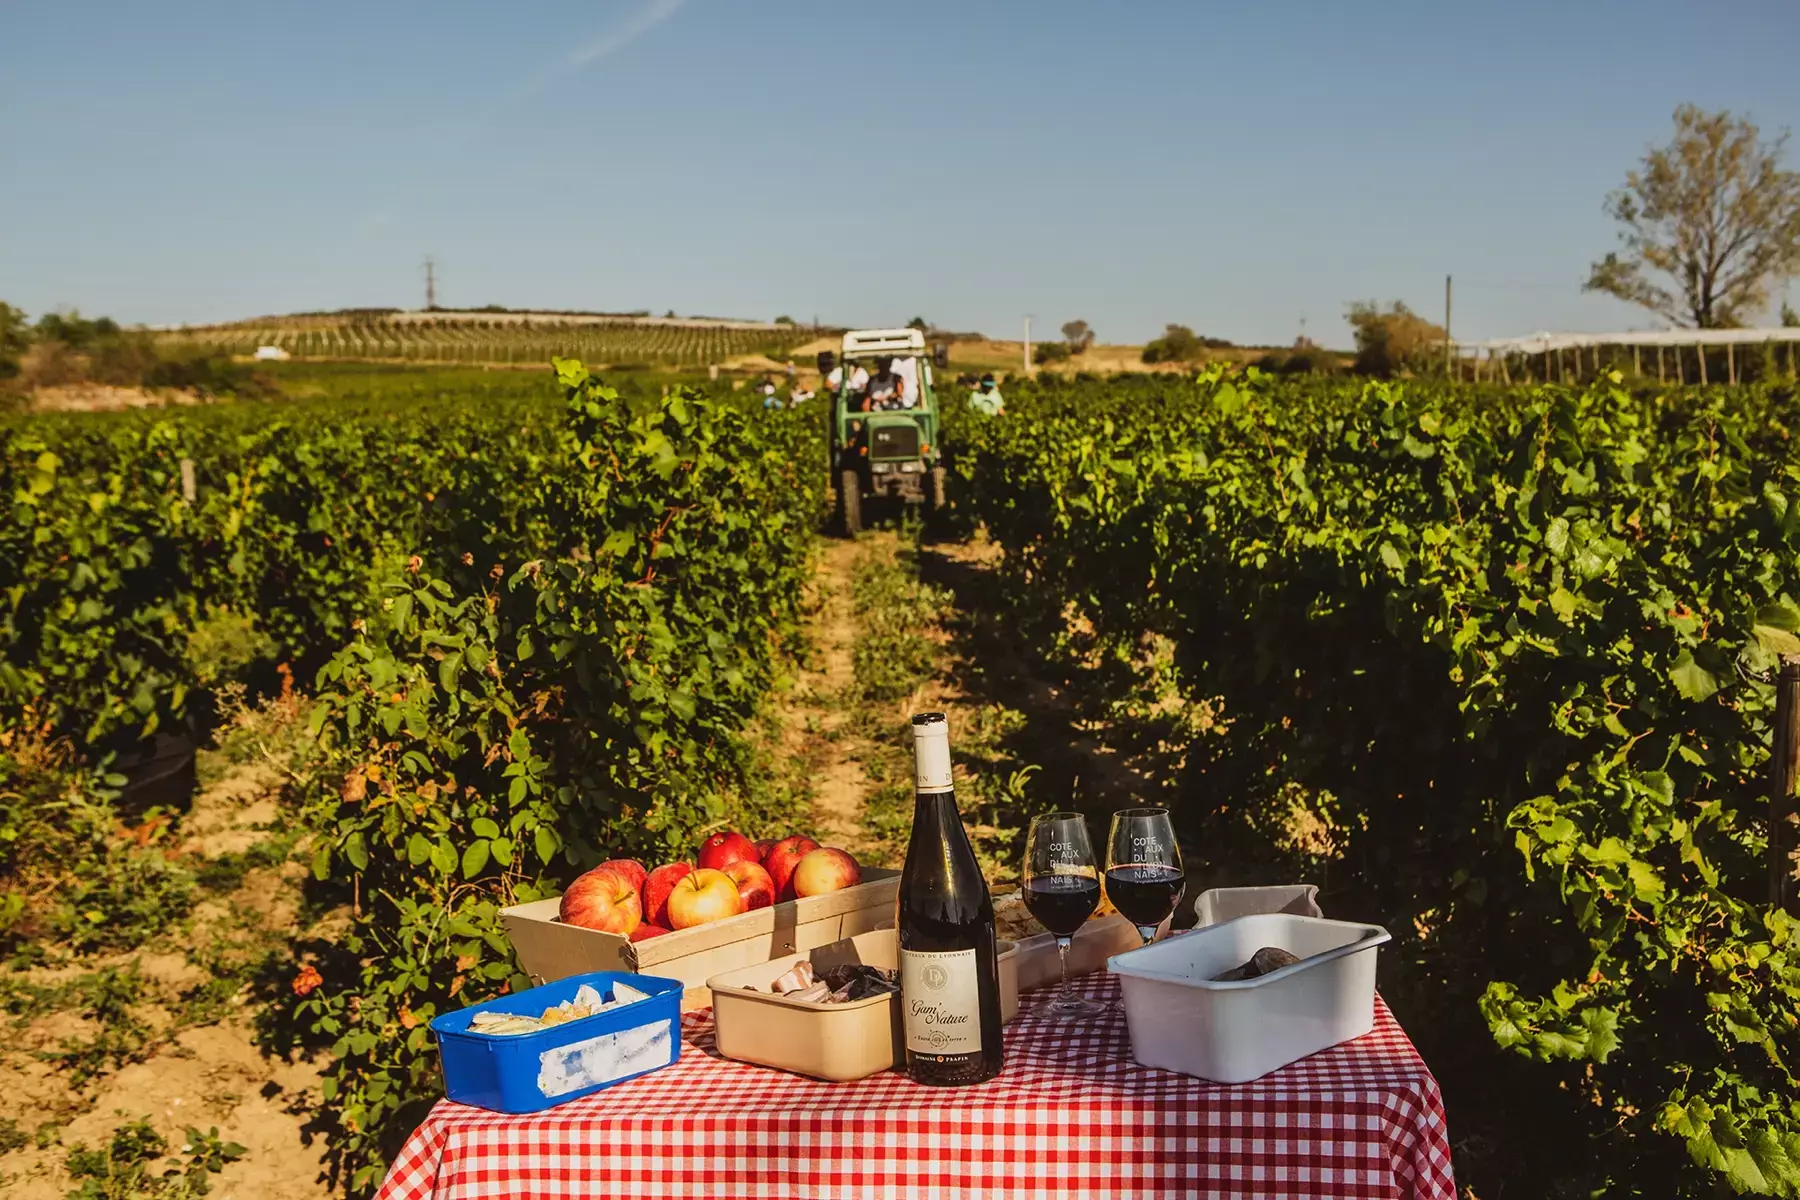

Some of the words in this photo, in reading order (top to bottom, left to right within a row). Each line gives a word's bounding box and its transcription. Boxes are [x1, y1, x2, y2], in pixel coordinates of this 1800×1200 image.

[1133, 836, 1157, 847] COTE
[1049, 842, 1073, 852] COTE
[1145, 844, 1164, 854] AUX
[1061, 849, 1080, 859] AUX
[1133, 853, 1148, 862] DU
[1134, 870, 1157, 879] NAIS
[1050, 876, 1074, 885] NAIS
[925, 1010, 969, 1025] Nature
